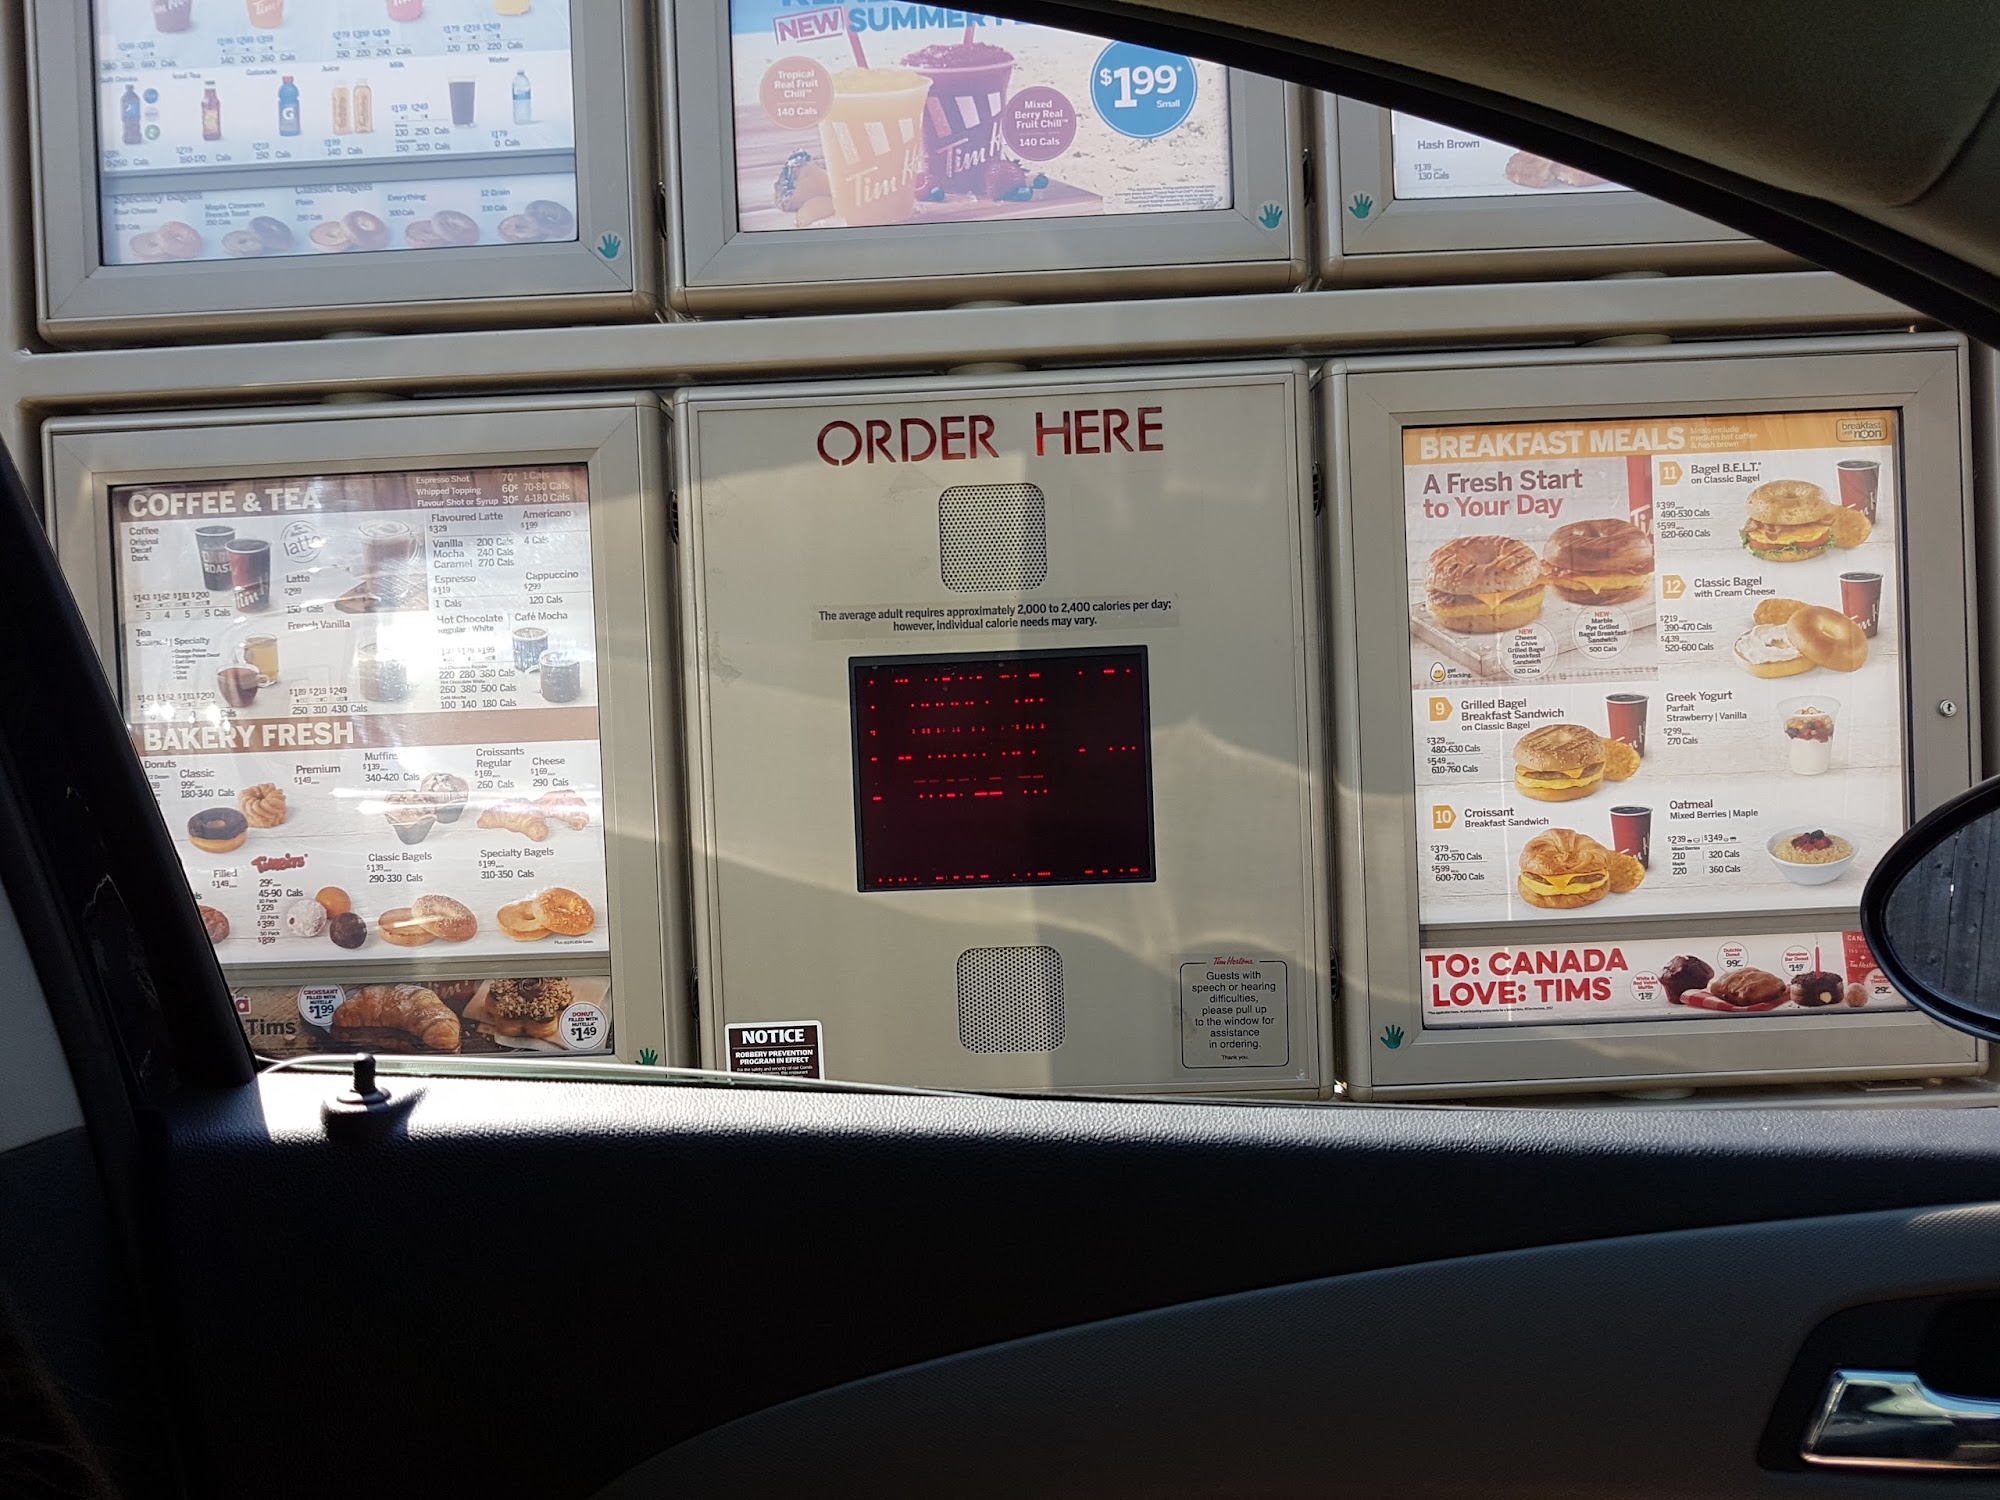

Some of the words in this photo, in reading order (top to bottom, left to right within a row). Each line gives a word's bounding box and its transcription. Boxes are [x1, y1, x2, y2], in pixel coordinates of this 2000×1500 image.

[778, 11, 839, 42] NEW
[777, 70, 815, 80] Tropical
[774, 80, 795, 89] Real
[797, 79, 818, 88] Fruit
[1024, 100, 1053, 109] Mixed
[1156, 99, 1181, 108] Small
[777, 108, 795, 116] 140
[797, 107, 817, 116] Cals
[1015, 111, 1041, 120] Berry
[1043, 110, 1063, 119] Real
[1016, 121, 1038, 129] Fruit
[1019, 138, 1038, 147] 140
[1040, 137, 1060, 146] Cals
[1418, 140, 1444, 150] Hash
[1447, 140, 1480, 149] Brown
[1418, 172, 1432, 180] 130
[1434, 172, 1449, 180] Cals
[387, 193, 427, 203] Everything
[1842, 421, 1882, 430] breakfast
[817, 414, 999, 466] ORDER
[1036, 406, 1164, 456] HERE
[1420, 430, 1583, 460] BREAKFAST
[1590, 426, 1686, 452] MEALS
[1663, 467, 1678, 480] 11
[1691, 463, 1720, 476] Bagel
[1423, 474, 1441, 495] A
[1447, 470, 1512, 494] Fresh
[1520, 468, 1584, 492] Start
[1704, 475, 1734, 484] Classic
[1736, 474, 1760, 484] Bagel
[416, 488, 450, 496] Whipped
[452, 486, 482, 496] Topping
[128, 490, 236, 518] COFFEE
[242, 492, 262, 512] &
[265, 487, 322, 510] TEA
[1423, 498, 1450, 519] to
[1454, 496, 1510, 516] Your
[1517, 494, 1564, 519] Day
[431, 513, 476, 522] Flavoured
[478, 512, 503, 520] Latte
[522, 510, 572, 520] Americano
[1660, 509, 1693, 518] 490-530
[1694, 508, 1710, 518] Cals
[129, 527, 160, 536] Coffee
[286, 575, 310, 583] Latte
[525, 570, 579, 582] Cappuccino
[1665, 580, 1682, 594] 12
[1694, 578, 1731, 588] Classic
[1733, 576, 1762, 588] Bagel
[1694, 588, 1712, 598] with
[1714, 588, 1742, 597] Cream
[1744, 587, 1776, 596] Cheese
[819, 610, 837, 620] The
[839, 612, 877, 622] average
[878, 609, 903, 619] adult
[905, 608, 944, 620] requires
[947, 604, 1016, 618] approximately
[1018, 604, 1046, 615] 2,000
[1048, 604, 1059, 614] to
[1061, 602, 1090, 614] 2,400
[1092, 601, 1131, 612] calories
[1133, 602, 1148, 612] per
[1151, 600, 1172, 610] day;
[514, 612, 536, 622] Café
[538, 612, 568, 621] Mocha
[893, 621, 935, 632] however,
[937, 618, 983, 630] individual
[986, 618, 1018, 628] calorie
[1020, 616, 1050, 627] needs
[1052, 618, 1072, 627] may
[1074, 616, 1097, 626] vary.
[1666, 692, 1697, 702] Greek
[1699, 690, 1732, 703] Yogurt
[1435, 702, 1444, 716] 9
[1460, 700, 1496, 710] Grilled
[1498, 698, 1527, 710] Bagel
[1666, 703, 1695, 712] Parfait
[1461, 710, 1512, 722] Breakfast
[1514, 708, 1564, 720] Sandwich
[1666, 713, 1714, 724] Strawberry
[1719, 712, 1747, 720] Vanilla
[1474, 722, 1504, 731] Classic
[1506, 721, 1530, 730] Bagel
[144, 726, 255, 752] BAKERY
[262, 722, 354, 747] FRESH
[476, 748, 524, 757] Croissants
[1430, 745, 1463, 754] 480-630
[1464, 744, 1480, 753] Cals
[476, 758, 512, 768] Regular
[532, 756, 566, 766] Cheese
[296, 765, 341, 774] Premium
[181, 789, 214, 798] 180-340
[218, 788, 235, 798] Cals
[1670, 798, 1713, 810] Oatmeal
[1435, 810, 1451, 824] 10
[1464, 808, 1514, 818] Croissant
[1670, 811, 1694, 820] Mixed
[1696, 810, 1727, 819] Berries
[1732, 808, 1758, 819] Maple
[1465, 819, 1506, 828] Breakfast
[1508, 818, 1550, 826] Sandwich
[368, 852, 400, 862] Classic
[402, 852, 432, 862] Bagels
[480, 849, 522, 860] Specialty
[524, 848, 554, 858] Bagels
[1214, 956, 1226, 965] Tim
[1425, 954, 1480, 978] TO:
[1488, 948, 1628, 976] CANADA
[1206, 971, 1240, 980] Guests
[1242, 970, 1261, 980] with
[1192, 984, 1226, 994] speech
[1228, 984, 1238, 992] or
[1241, 982, 1276, 992] hearing
[1210, 994, 1258, 1004] difficulties,
[1432, 980, 1526, 1008] LOVE:
[1202, 1006, 1232, 1016] please
[1236, 1006, 1252, 1015] pull
[1256, 1006, 1267, 1014] up
[1195, 1018, 1204, 1026] to
[1207, 1018, 1221, 1026] the
[1224, 1017, 1258, 1026] window
[1262, 1016, 1274, 1024] for
[246, 1018, 297, 1036] Tims
[742, 1029, 805, 1044] NOTICE
[1210, 1028, 1260, 1038] assistance
[1209, 1040, 1217, 1048] in
[1220, 1040, 1262, 1050] ordering.
